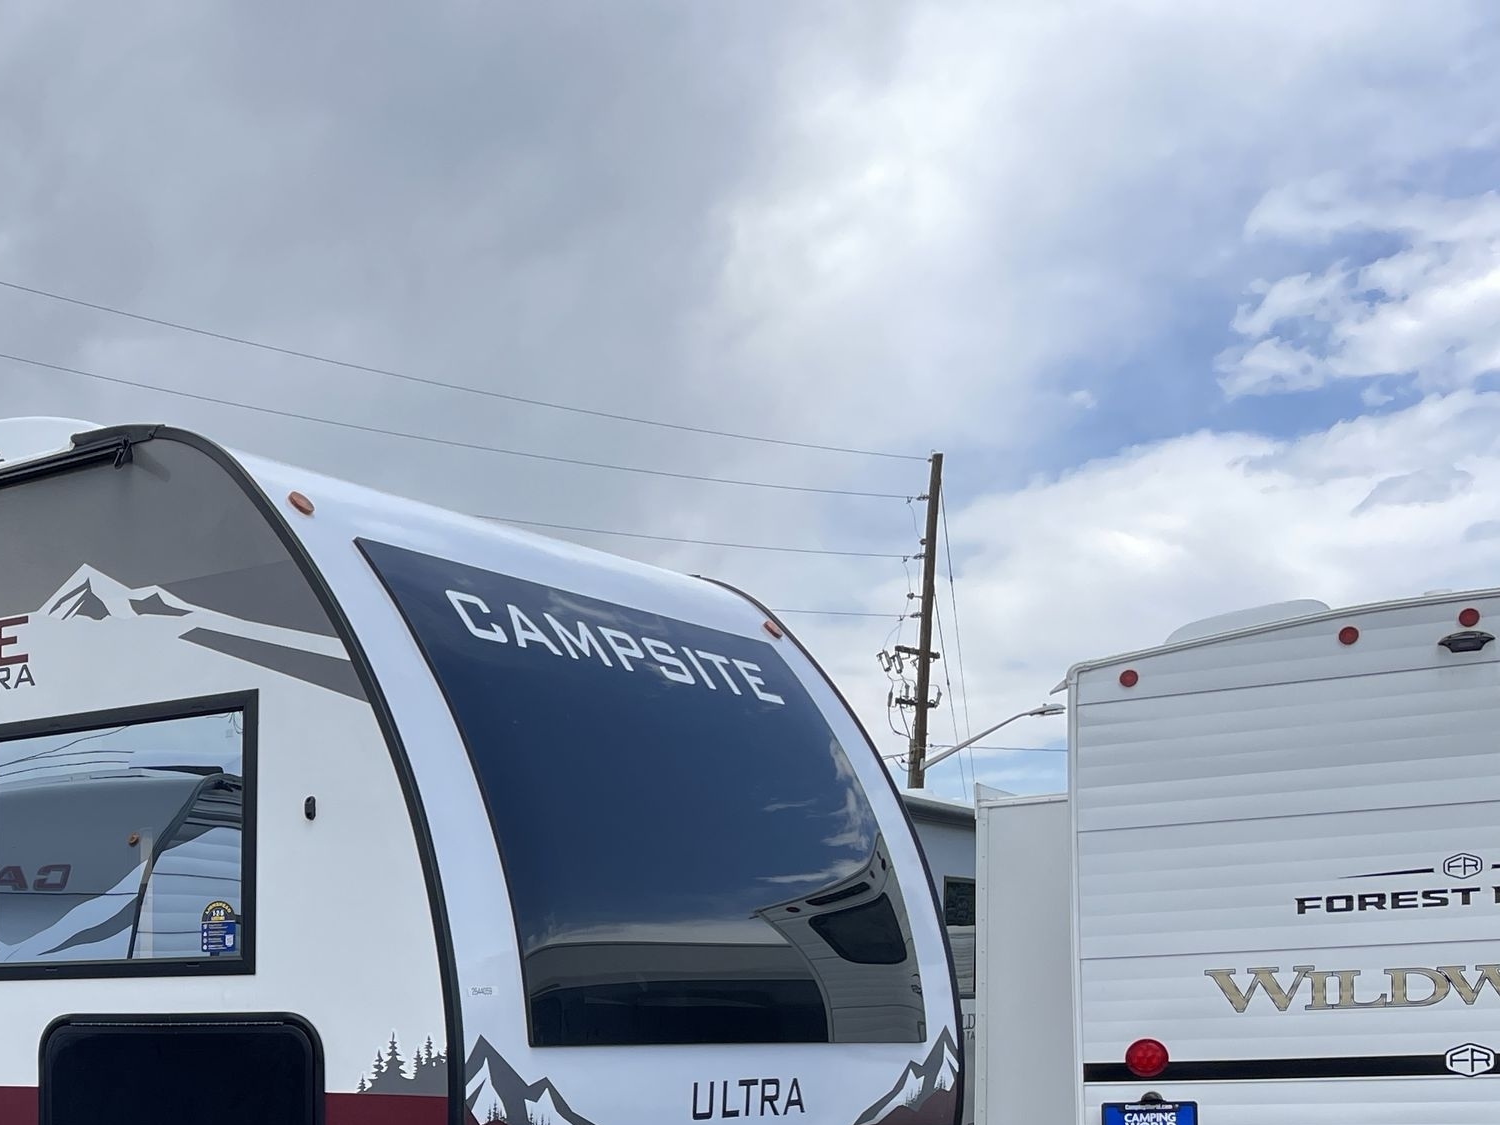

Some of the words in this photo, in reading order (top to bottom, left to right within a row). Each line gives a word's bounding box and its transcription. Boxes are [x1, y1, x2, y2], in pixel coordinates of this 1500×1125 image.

[445, 590, 785, 705] CAMPSITE
[1294, 887, 1481, 915] FOREST
[692, 1078, 805, 1120] ULTRA
[1124, 1112, 1177, 1122] CAMPING
